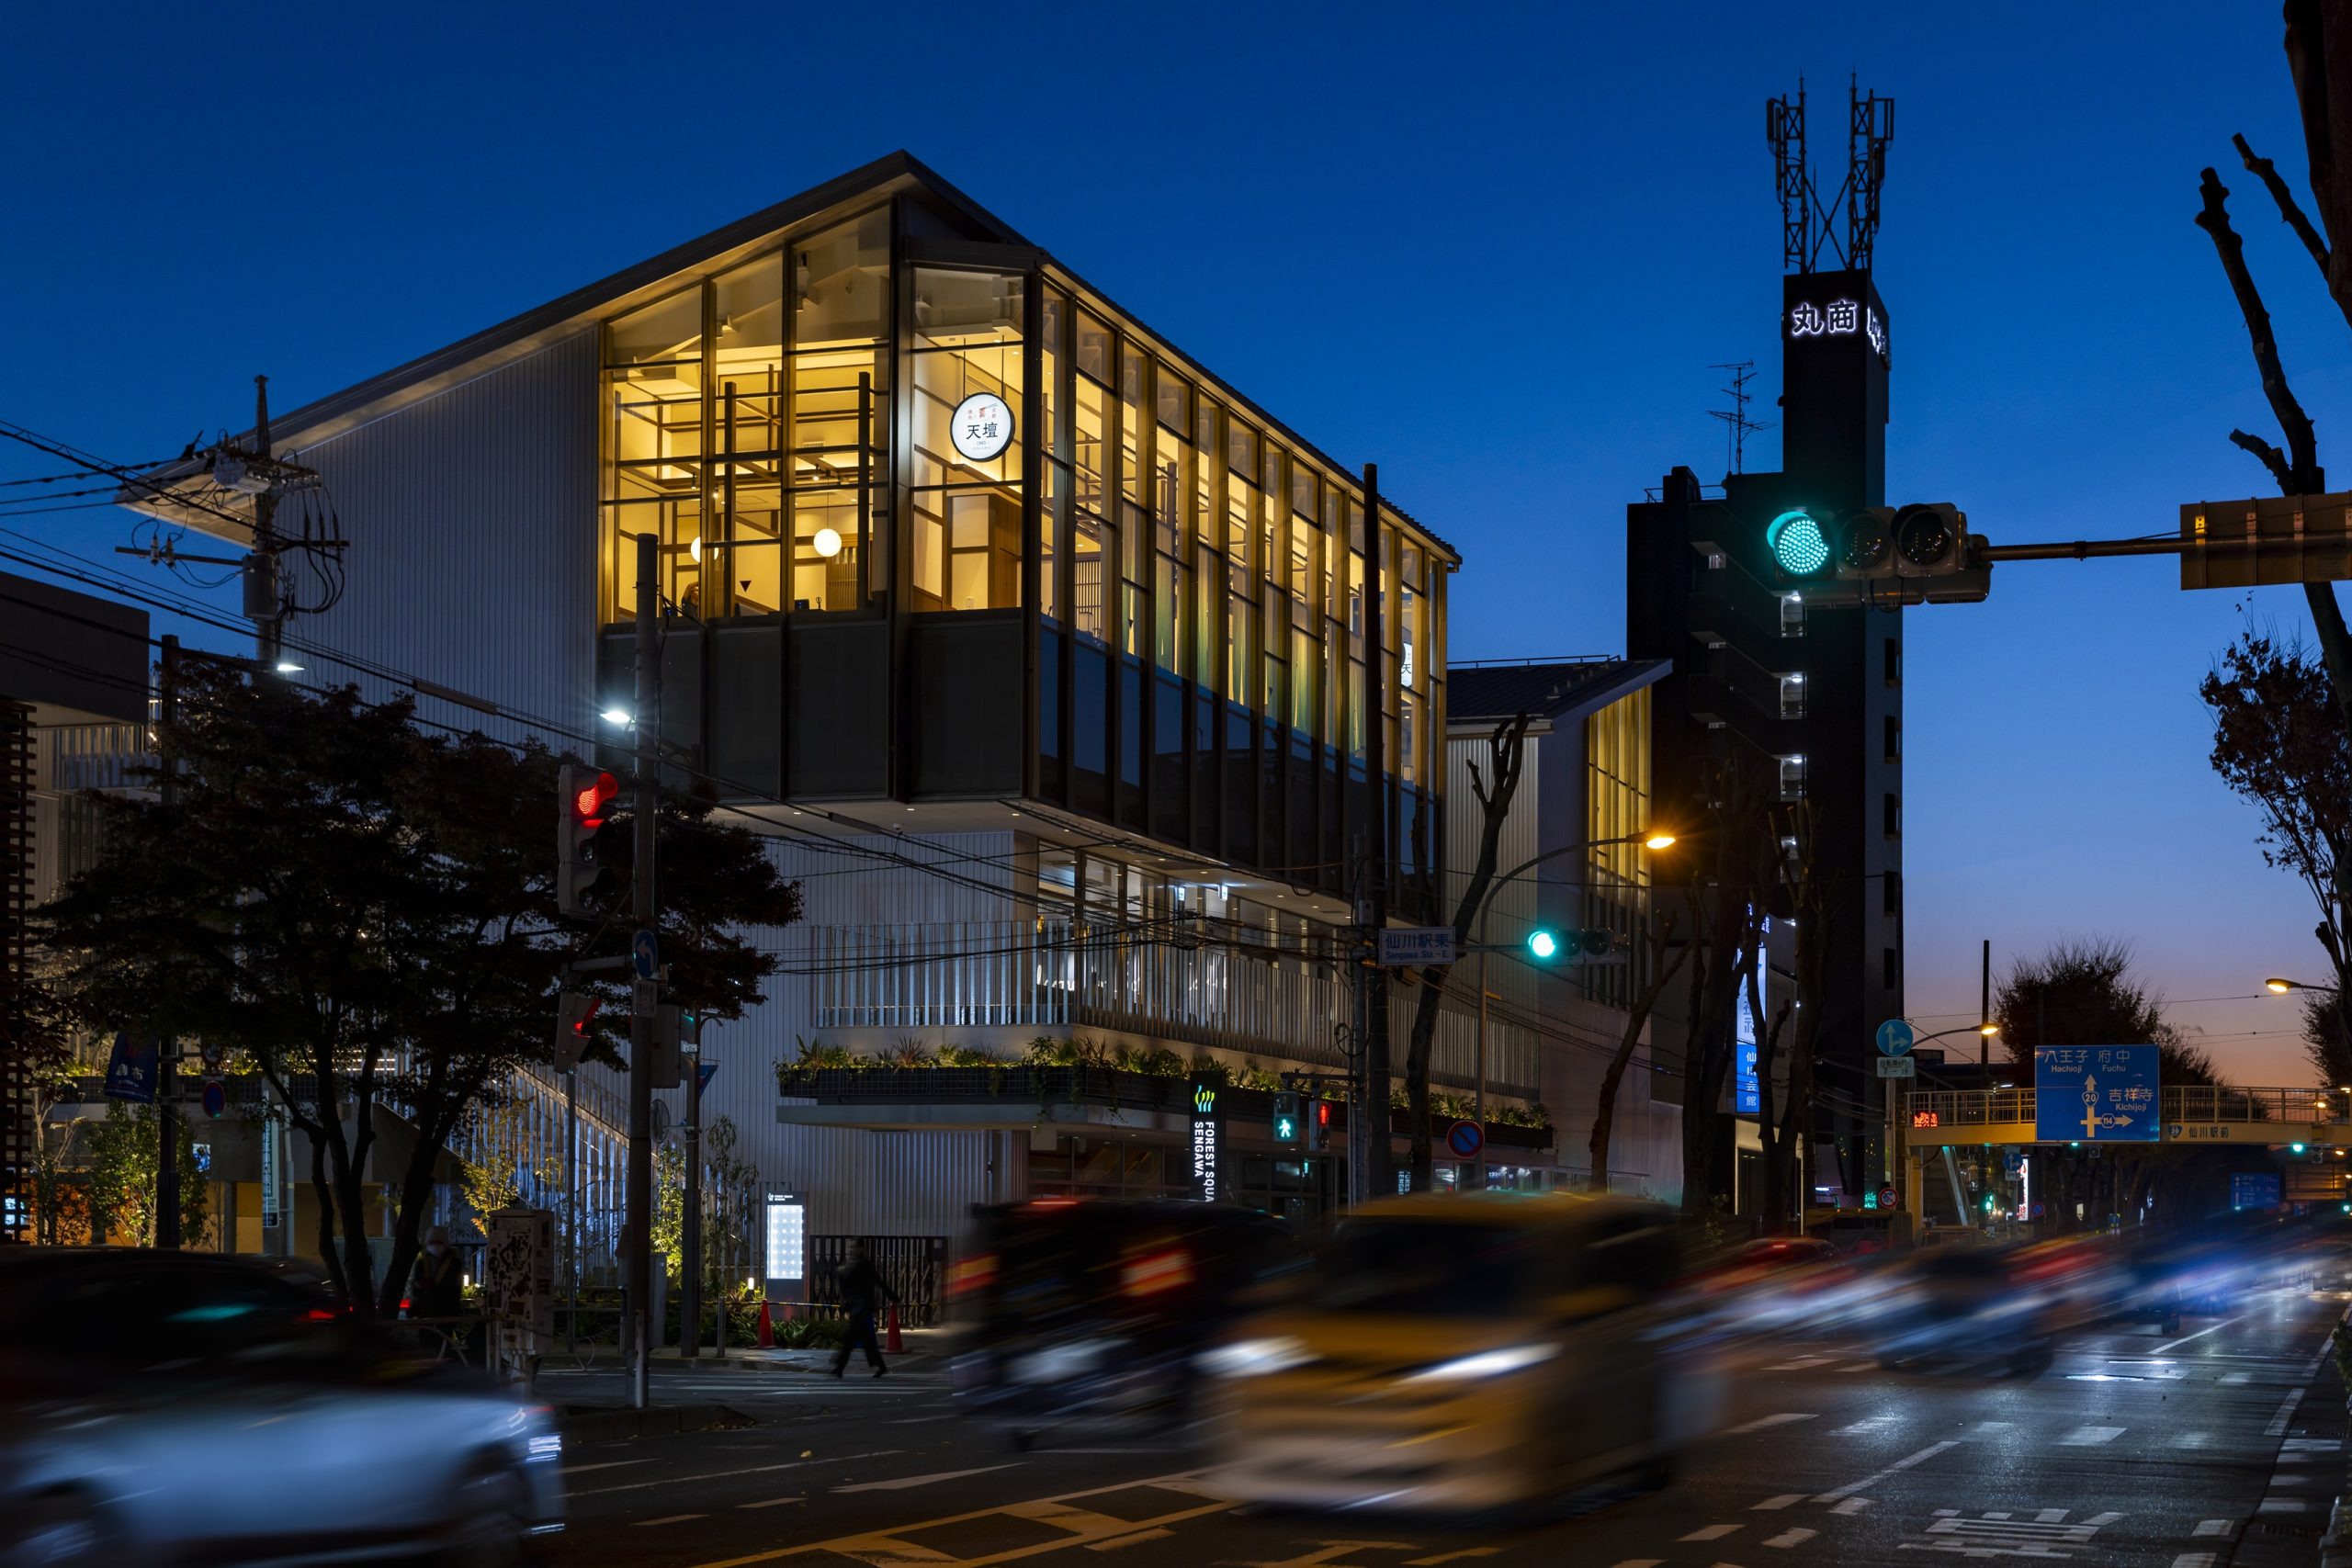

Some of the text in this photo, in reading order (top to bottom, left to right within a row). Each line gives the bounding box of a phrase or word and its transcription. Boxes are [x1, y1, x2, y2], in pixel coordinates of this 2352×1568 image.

[1792, 299, 1856, 335] 丸商
[967, 422, 998, 440] 天壇
[1385, 932, 1449, 949] 仙川駅東
[2044, 1049, 2131, 1064] 八王子 府中
[2051, 1064, 2126, 1073] Hachioji Fuchu
[2085, 1093, 2096, 1101] 20
[2109, 1088, 2154, 1102] 吉祥寺
[1194, 1122, 1204, 1177] SENGAWA
[1205, 1122, 1215, 1168] FOREST
